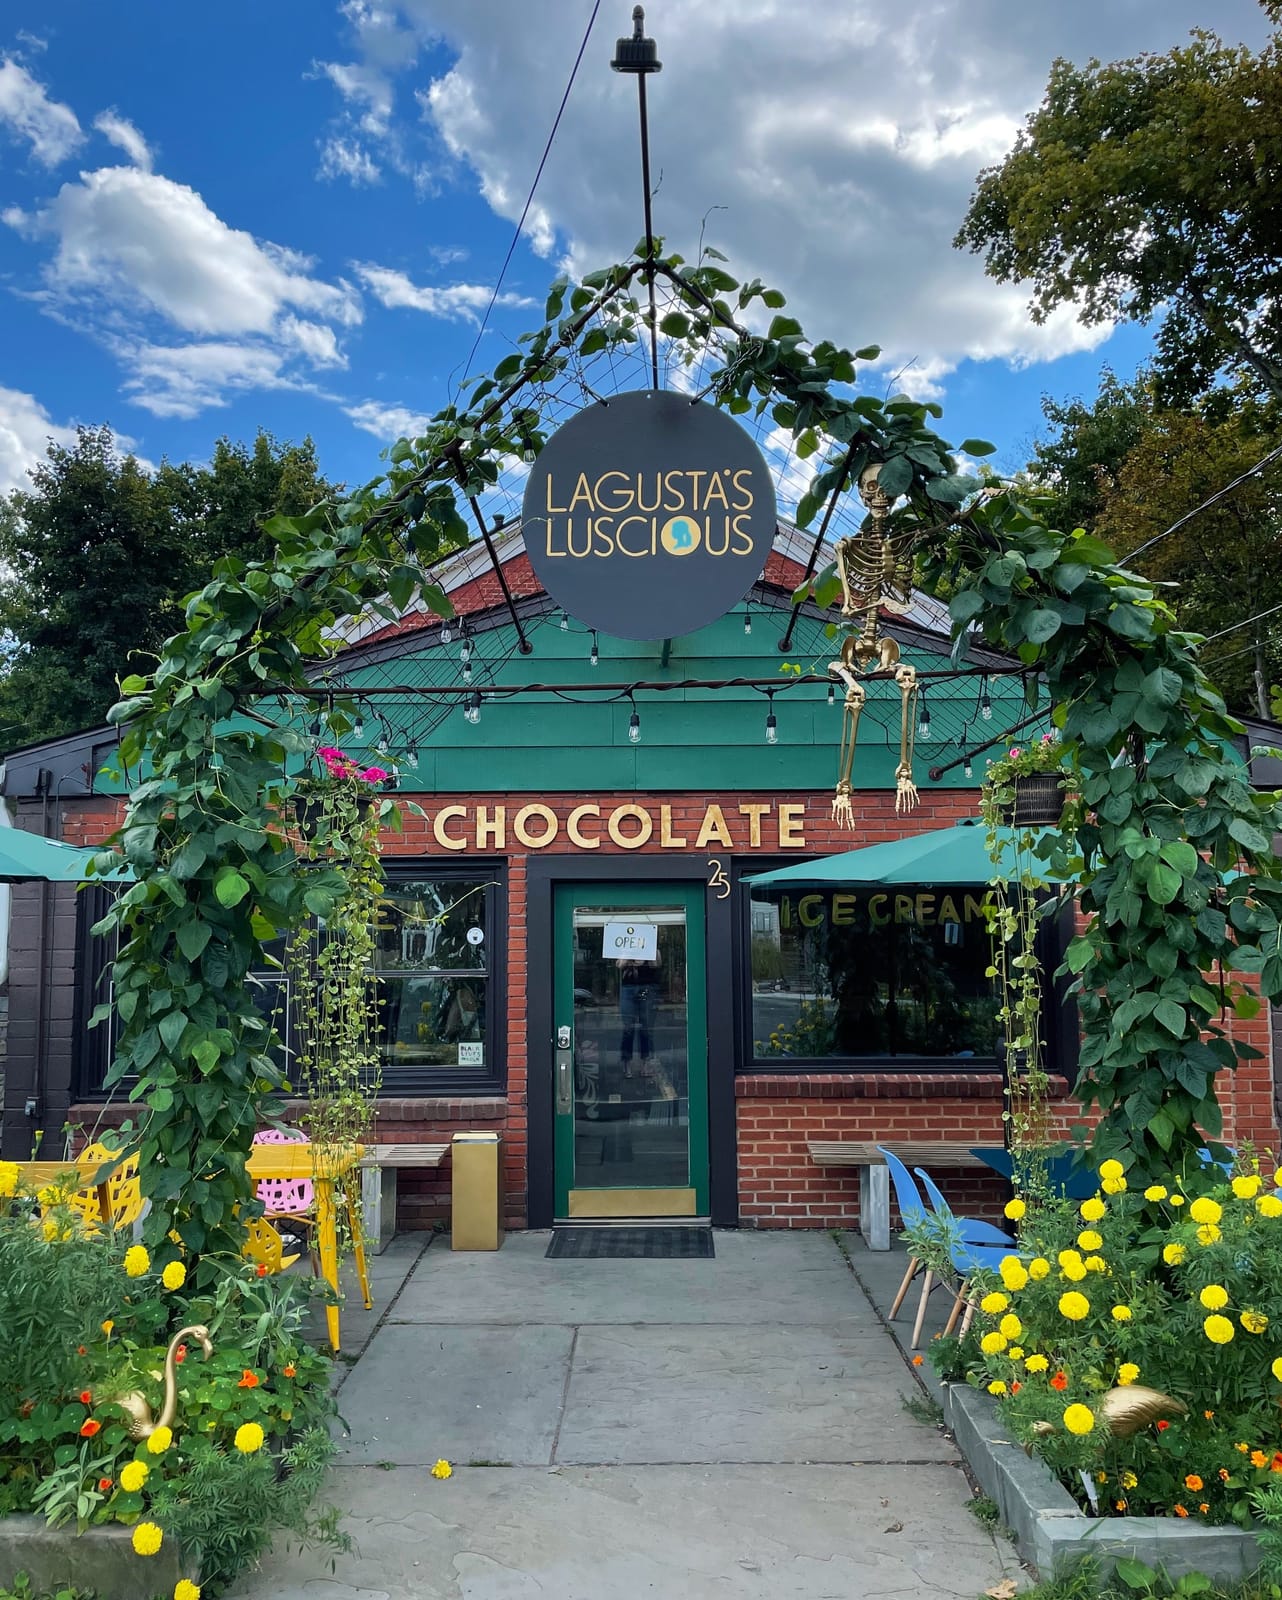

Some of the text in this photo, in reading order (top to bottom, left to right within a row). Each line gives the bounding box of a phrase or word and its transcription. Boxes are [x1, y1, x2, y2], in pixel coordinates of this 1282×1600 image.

[546, 469, 754, 513] LAGUSTA'S
[546, 514, 754, 557] LUSCIOUS
[432, 803, 807, 851] CHOCOLATE
[706, 859, 732, 900] 25
[780, 893, 987, 929] ICE CREAM
[614, 936, 646, 950] OPEN
